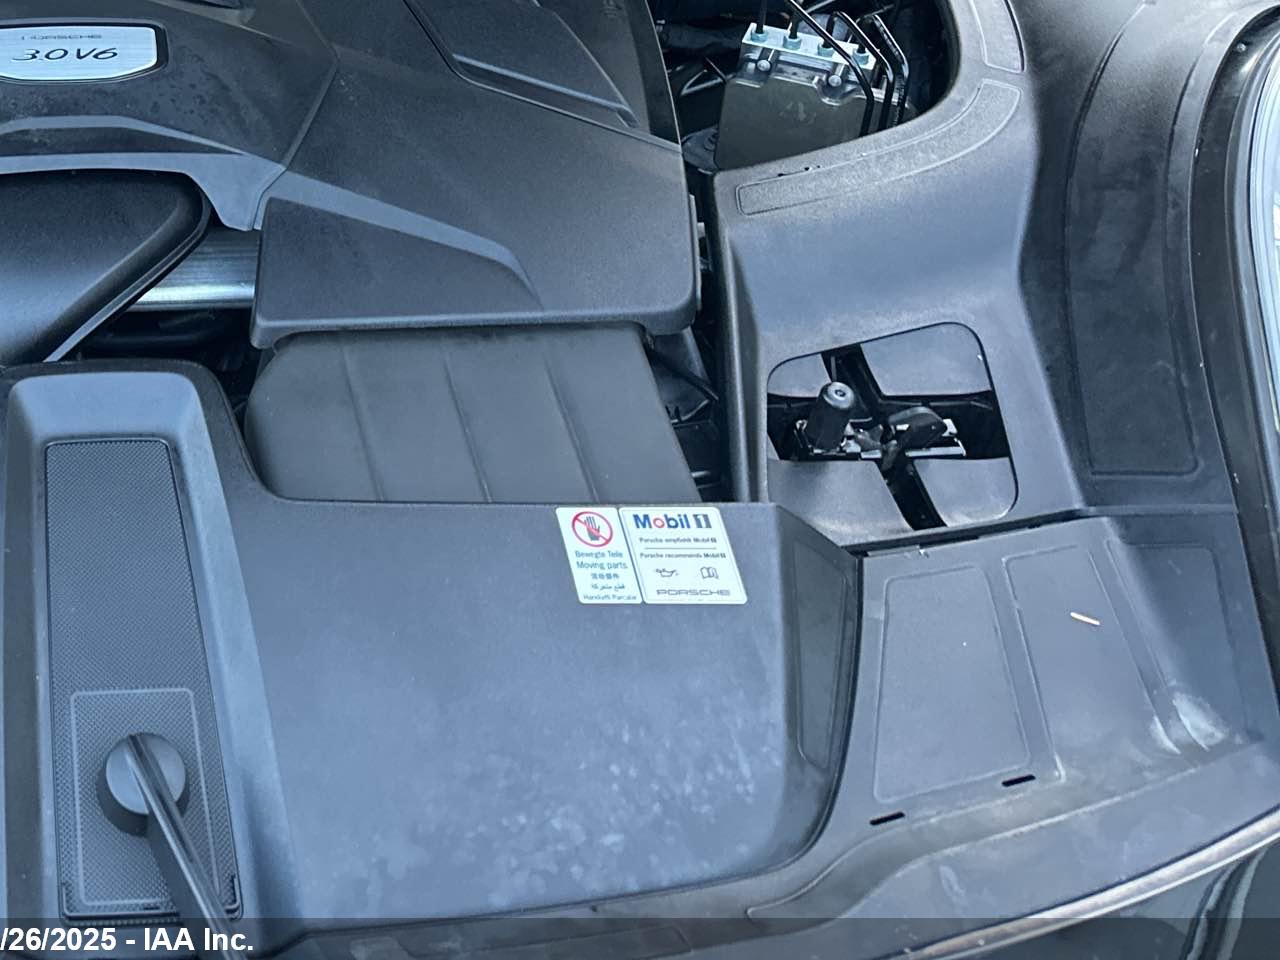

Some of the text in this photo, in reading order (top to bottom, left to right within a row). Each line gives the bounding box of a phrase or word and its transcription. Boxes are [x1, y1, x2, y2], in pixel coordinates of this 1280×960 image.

[632, 513, 713, 529] Mobil 1
[576, 560, 629, 571] Moving parts
[656, 588, 731, 597] PORSCHE
